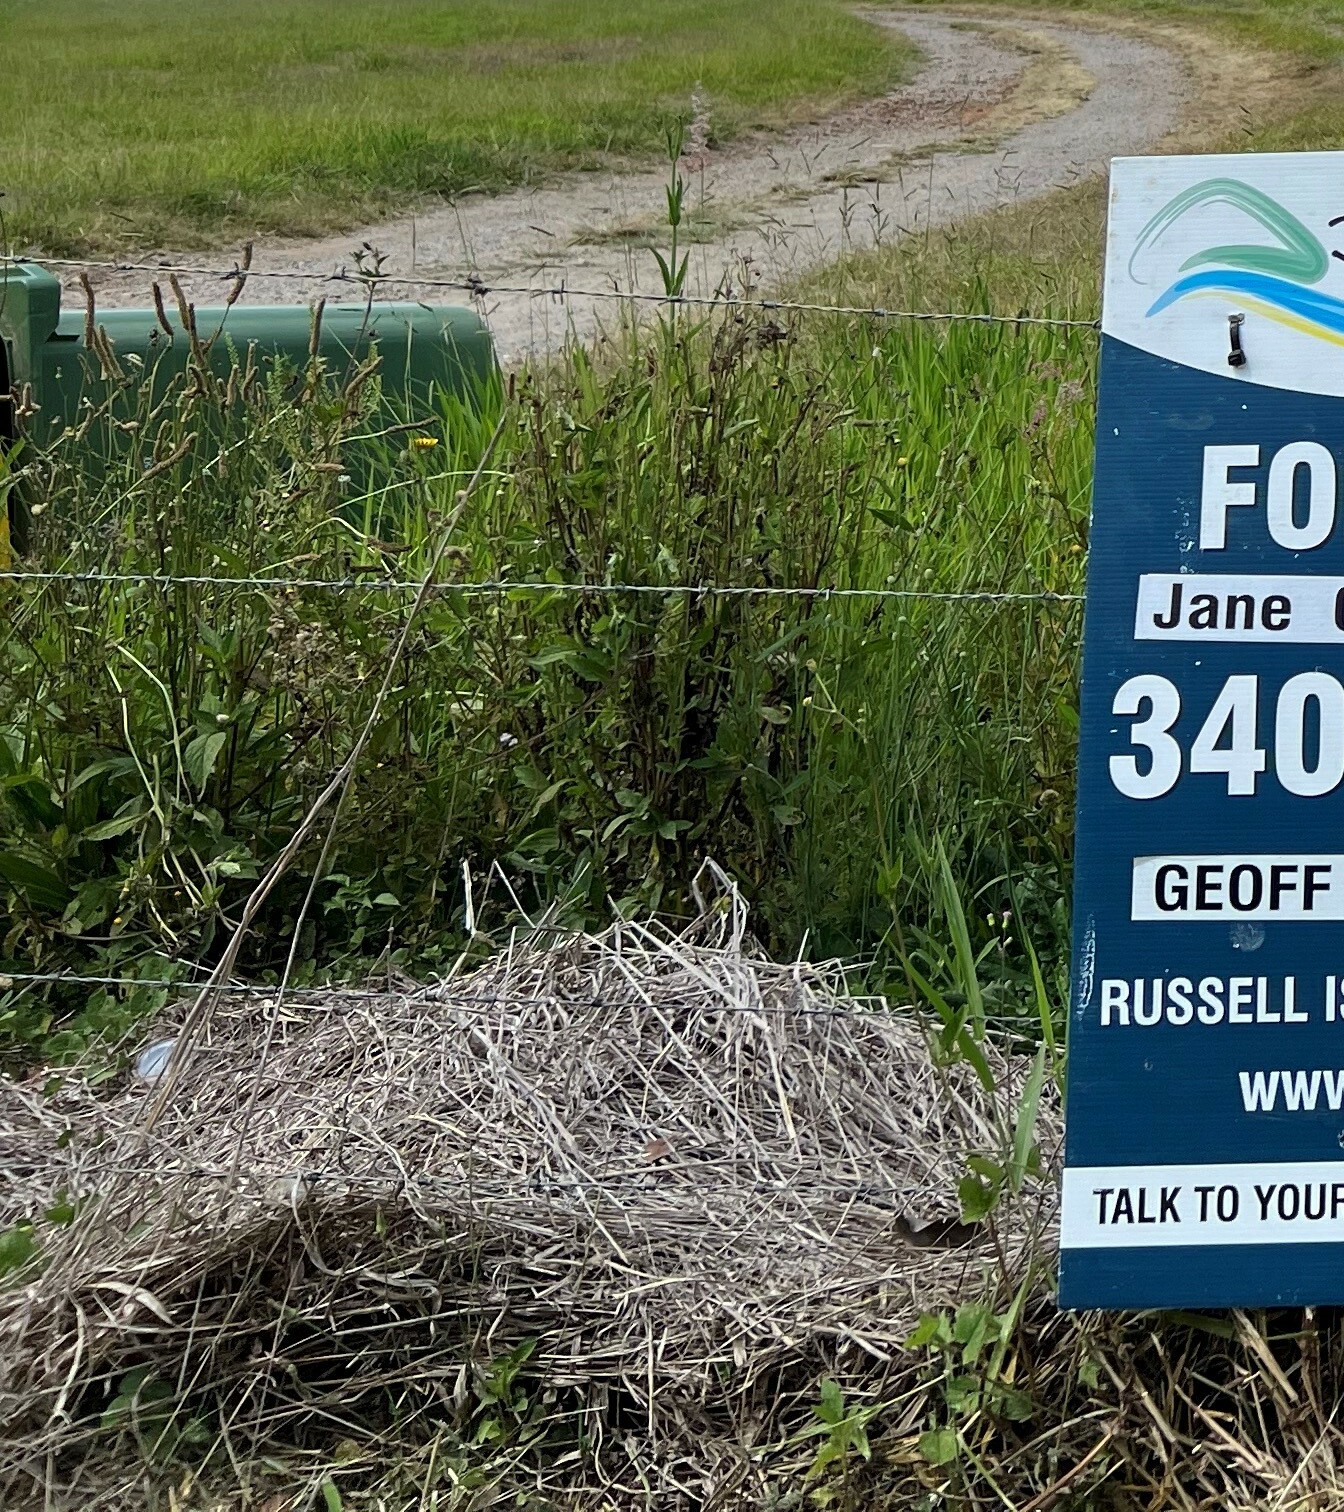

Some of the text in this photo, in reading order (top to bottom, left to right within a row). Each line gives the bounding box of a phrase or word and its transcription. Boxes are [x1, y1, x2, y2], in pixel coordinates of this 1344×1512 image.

[1153, 583, 1292, 632] Jane
[1155, 863, 1332, 911] GEOFF
[1101, 975, 1308, 1027] RUSSELL
[1094, 1185, 1178, 1225] TALK
[1196, 1185, 1239, 1223] TO
